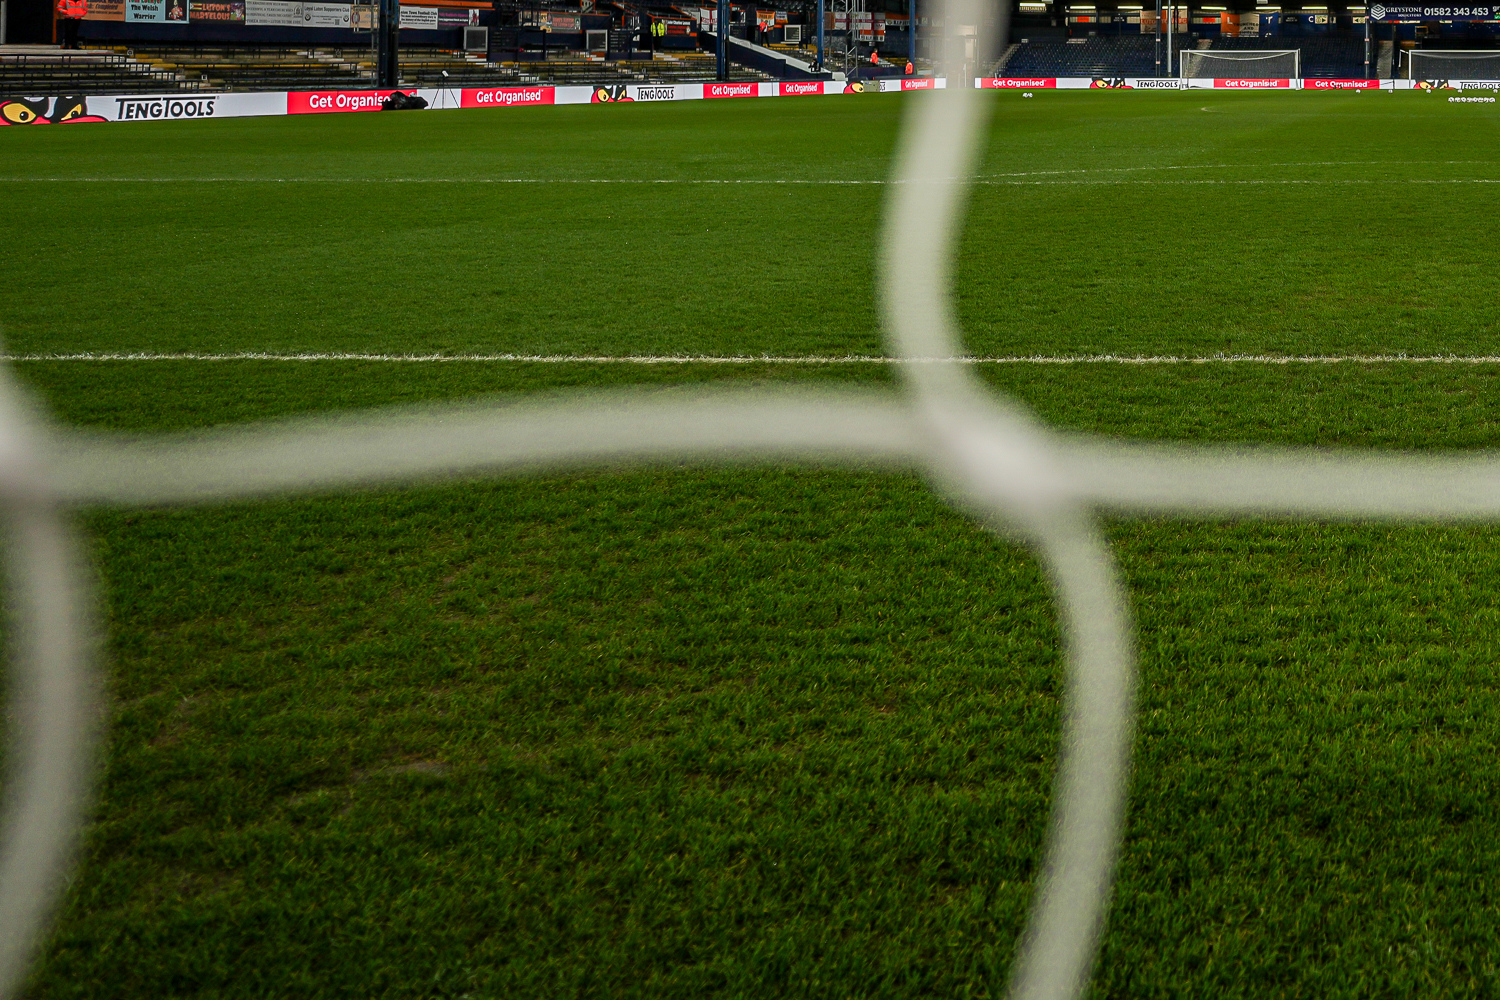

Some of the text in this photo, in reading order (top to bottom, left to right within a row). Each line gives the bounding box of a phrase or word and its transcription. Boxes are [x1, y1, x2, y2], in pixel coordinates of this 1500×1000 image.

[1424, 8, 1489, 16] 01582 343 453
[1007, 79, 1045, 88] Organised
[1136, 80, 1179, 88] TENGTOOLS
[1240, 80, 1278, 88] Organised
[1329, 80, 1368, 89] Organised
[636, 87, 675, 100] TENGTOOLS
[712, 85, 751, 97] Get Organised
[786, 84, 818, 95] Get Organised
[309, 94, 391, 110] Get Organis
[476, 90, 541, 104] Get Organised
[115, 96, 216, 120] TENGTOOLS
